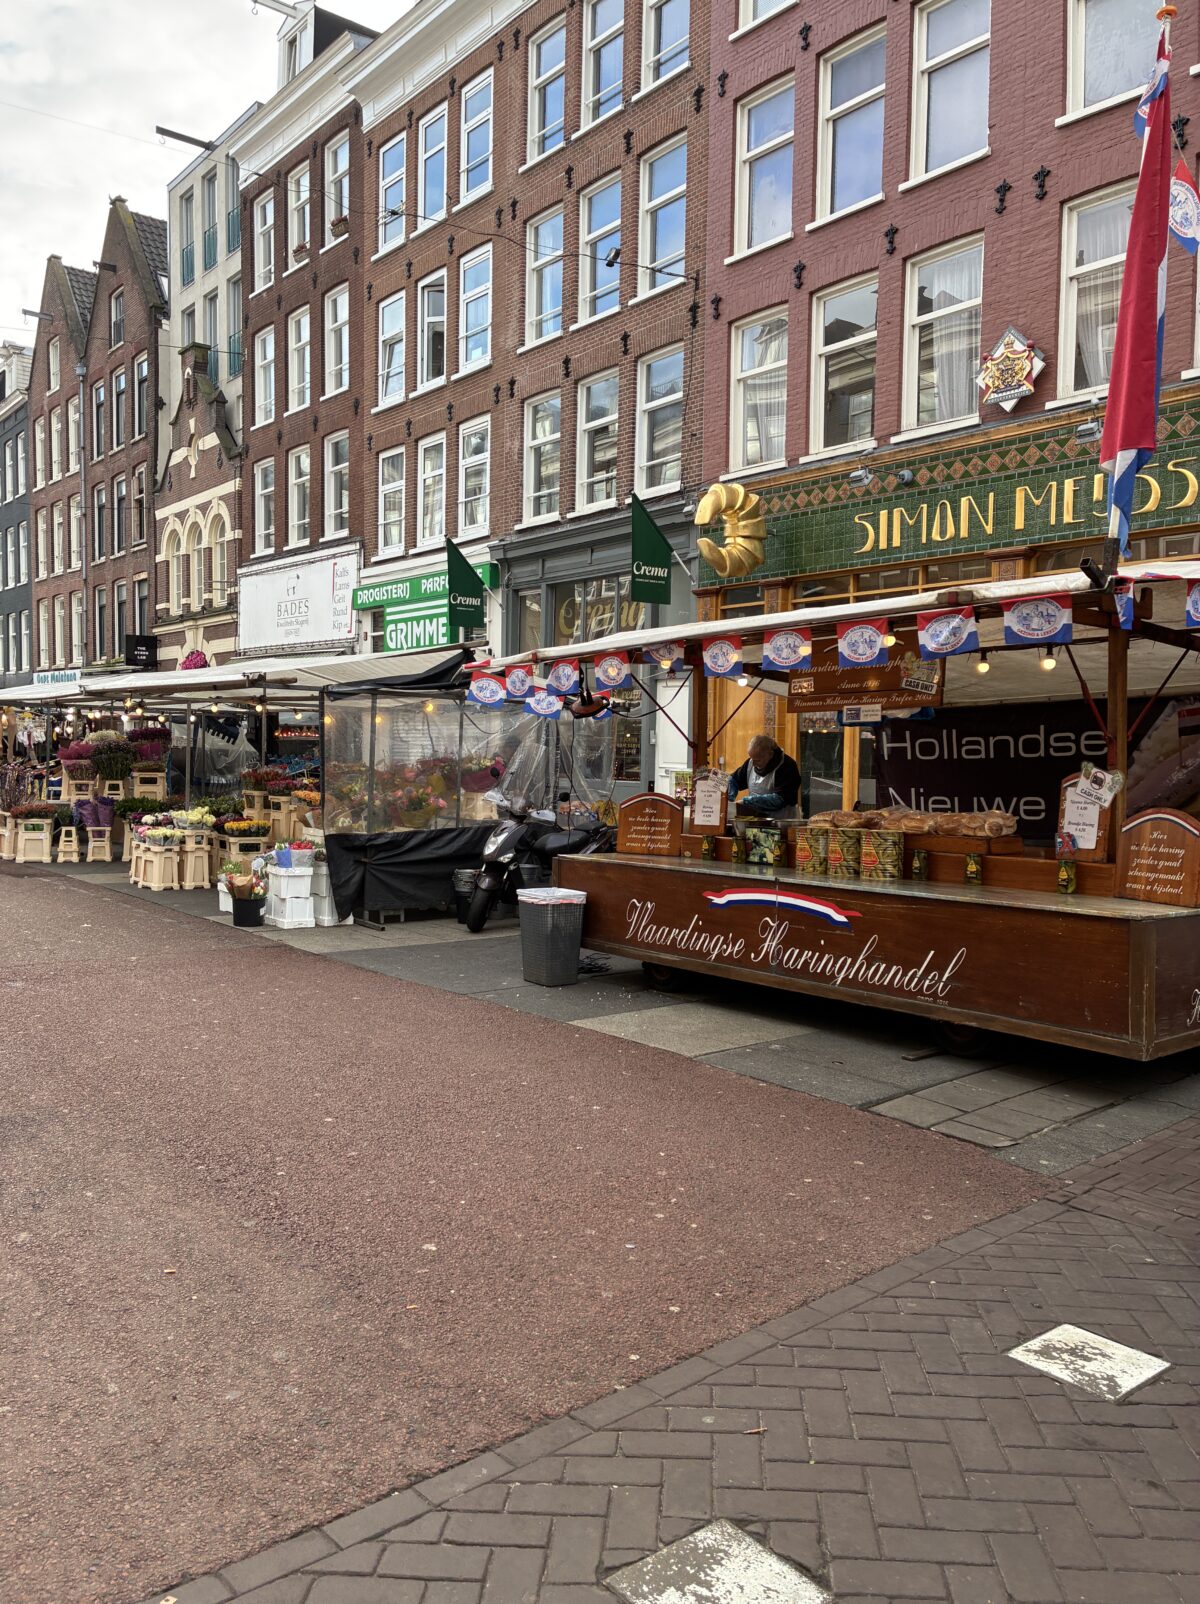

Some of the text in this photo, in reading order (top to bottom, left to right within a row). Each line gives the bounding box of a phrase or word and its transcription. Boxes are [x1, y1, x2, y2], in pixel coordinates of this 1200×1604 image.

[854, 492, 994, 554] SIMON
[633, 561, 668, 578] Crema
[358, 582, 410, 604] DROGISTERIJ
[450, 592, 481, 606] Crema
[277, 600, 310, 618] BADES
[333, 620, 342, 632] Kip
[386, 616, 448, 650] GRIMME
[904, 680, 934, 692] CASH ONLY
[882, 724, 1108, 760] Hollandse
[888, 786, 1046, 820] Nieuwe
[1080, 788, 1094, 798] CASH
[1094, 794, 1107, 804] ONLY
[1150, 831, 1167, 840] Hier
[1141, 843, 1158, 852] beste
[1159, 844, 1185, 856] haring
[1133, 856, 1182, 870] zonder graat
[1128, 868, 1185, 881] schoongemaakt
[1126, 882, 1145, 890] waar
[625, 898, 746, 962] Vlaardingse
[751, 917, 966, 997] Haringhandel
